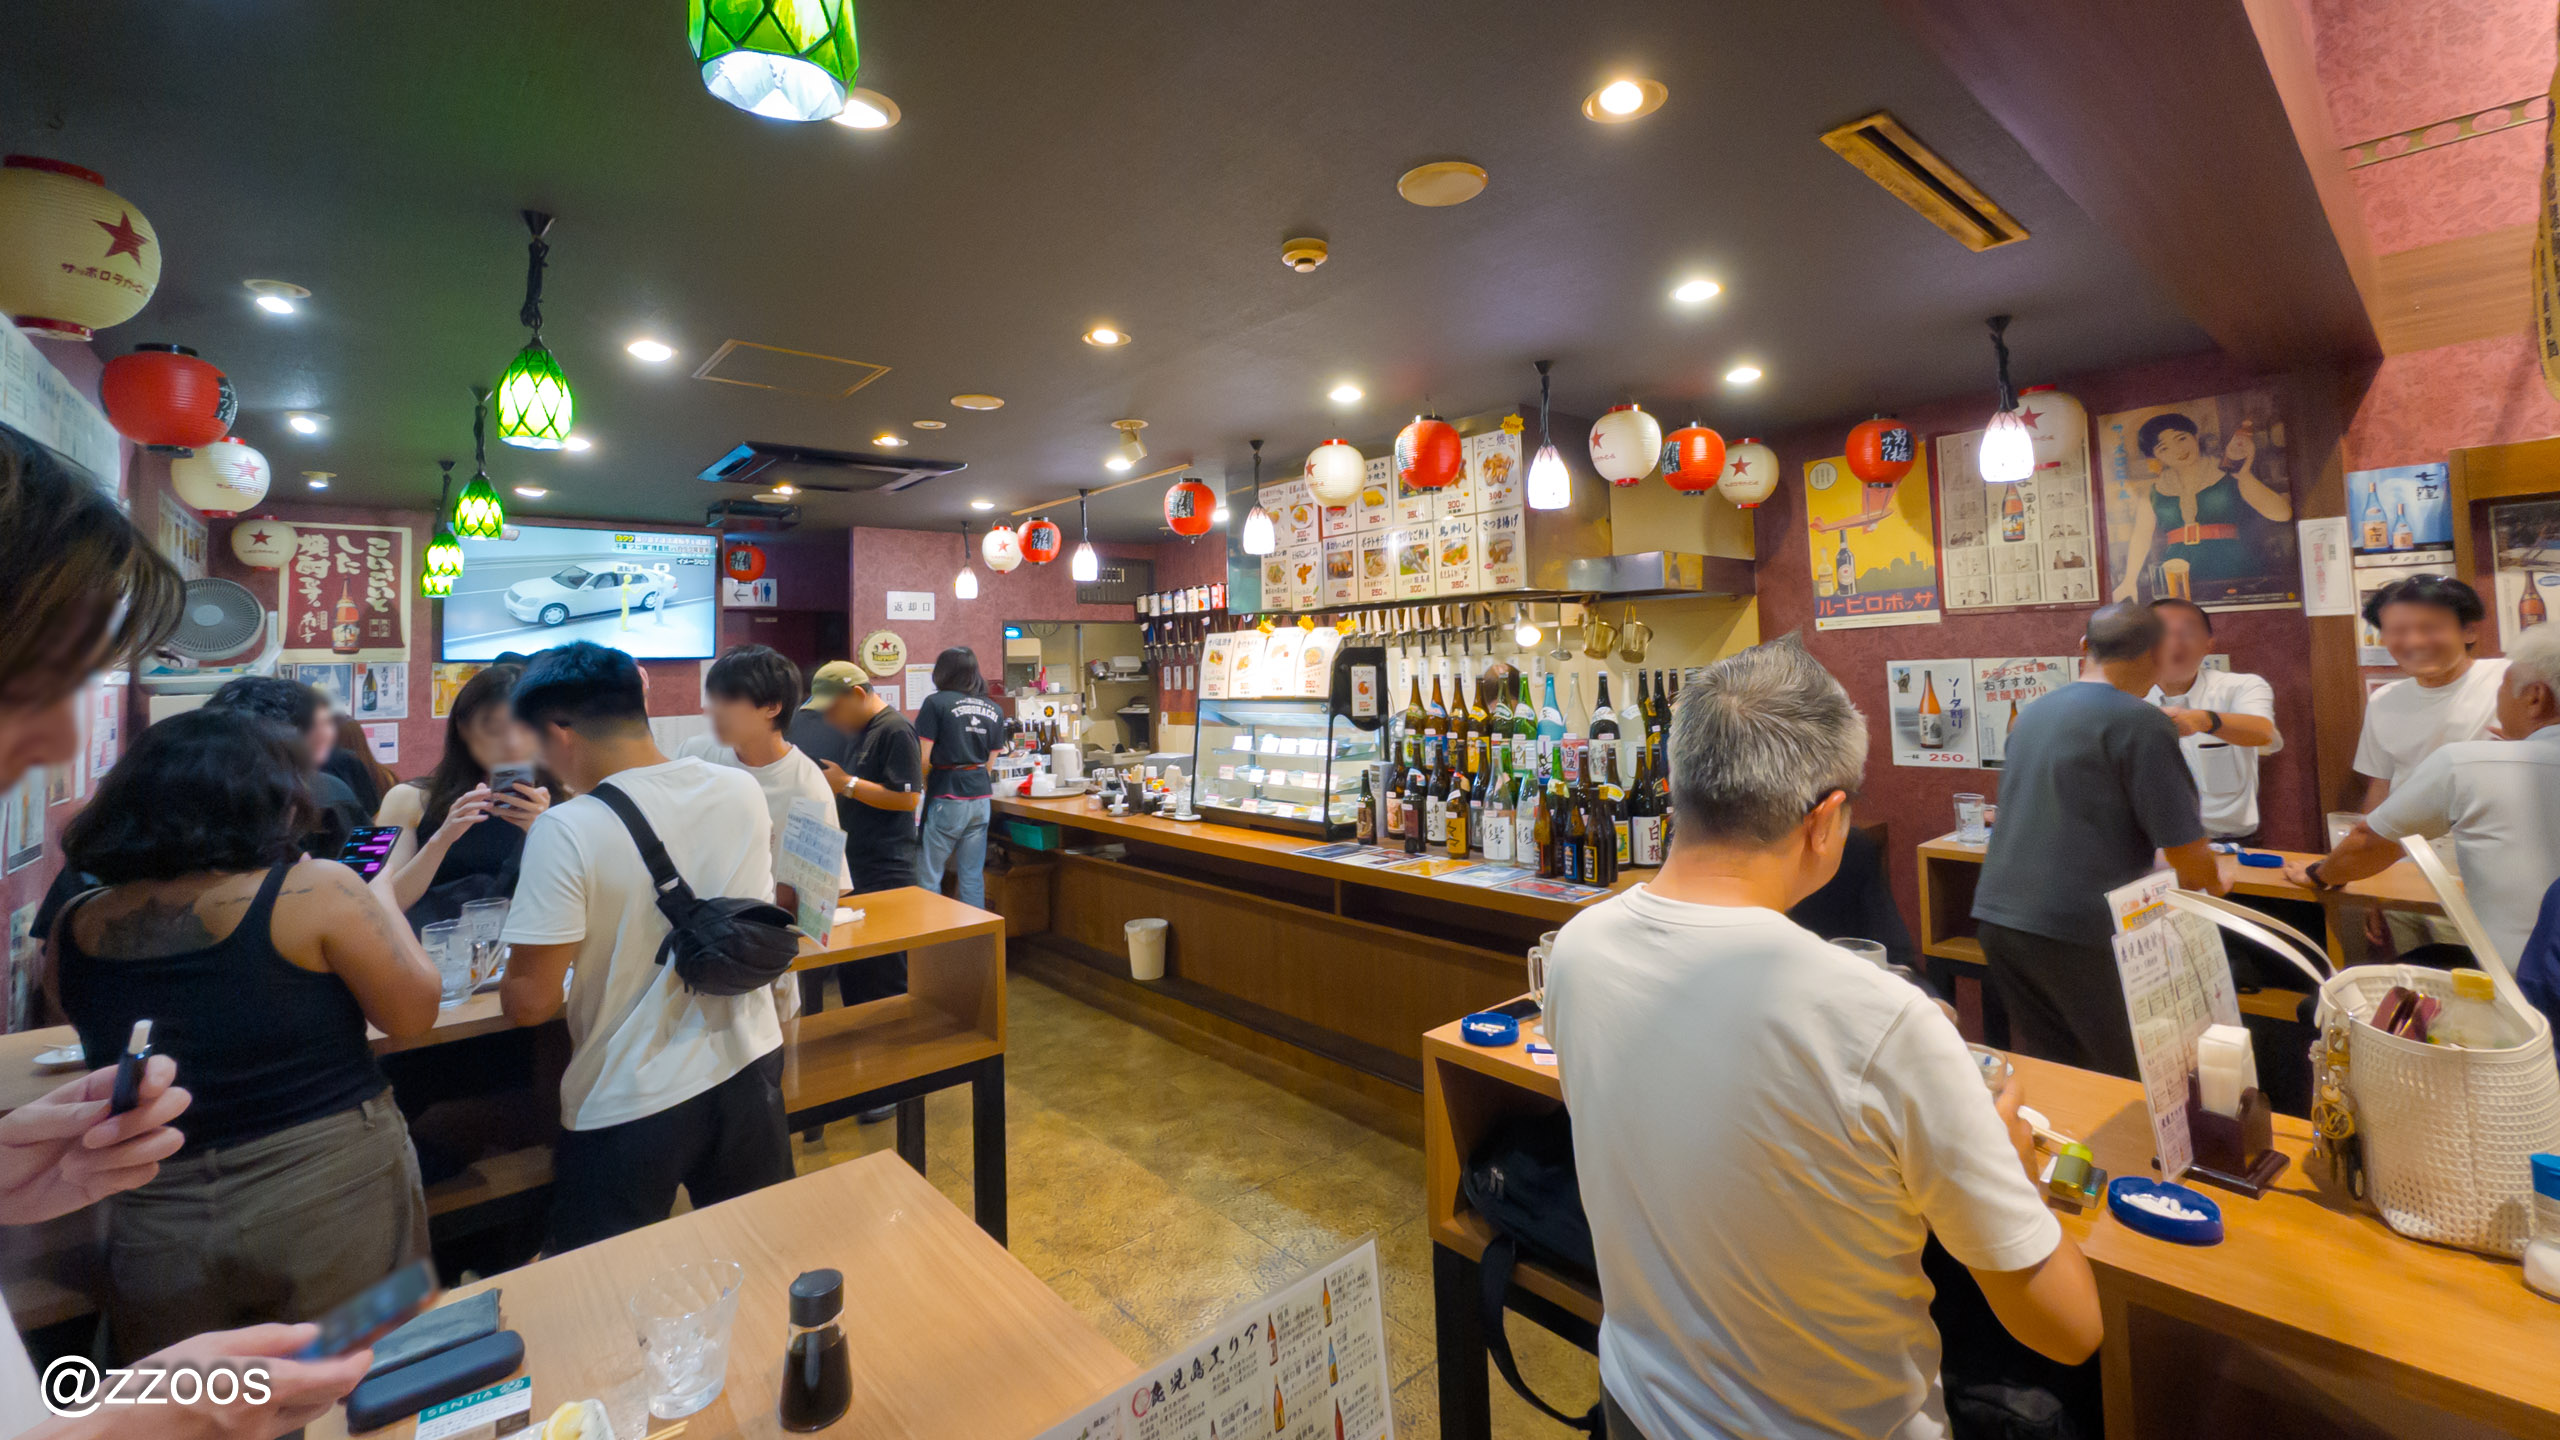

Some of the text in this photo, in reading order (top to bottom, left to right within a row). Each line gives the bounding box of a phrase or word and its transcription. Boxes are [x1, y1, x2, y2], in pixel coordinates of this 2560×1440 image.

[1881, 436, 1893, 462] サワー
[1890, 428, 1908, 462] 男梅
[1483, 514, 1519, 531] さつま揚げ
[893, 601, 931, 612] 返却口
[1984, 675, 2037, 691] おすすめ
[1566, 747, 1577, 770] 白波
[1150, 1322, 1258, 1408] 鹿児島エリア
[427, 1390, 493, 1418] SENTIA
